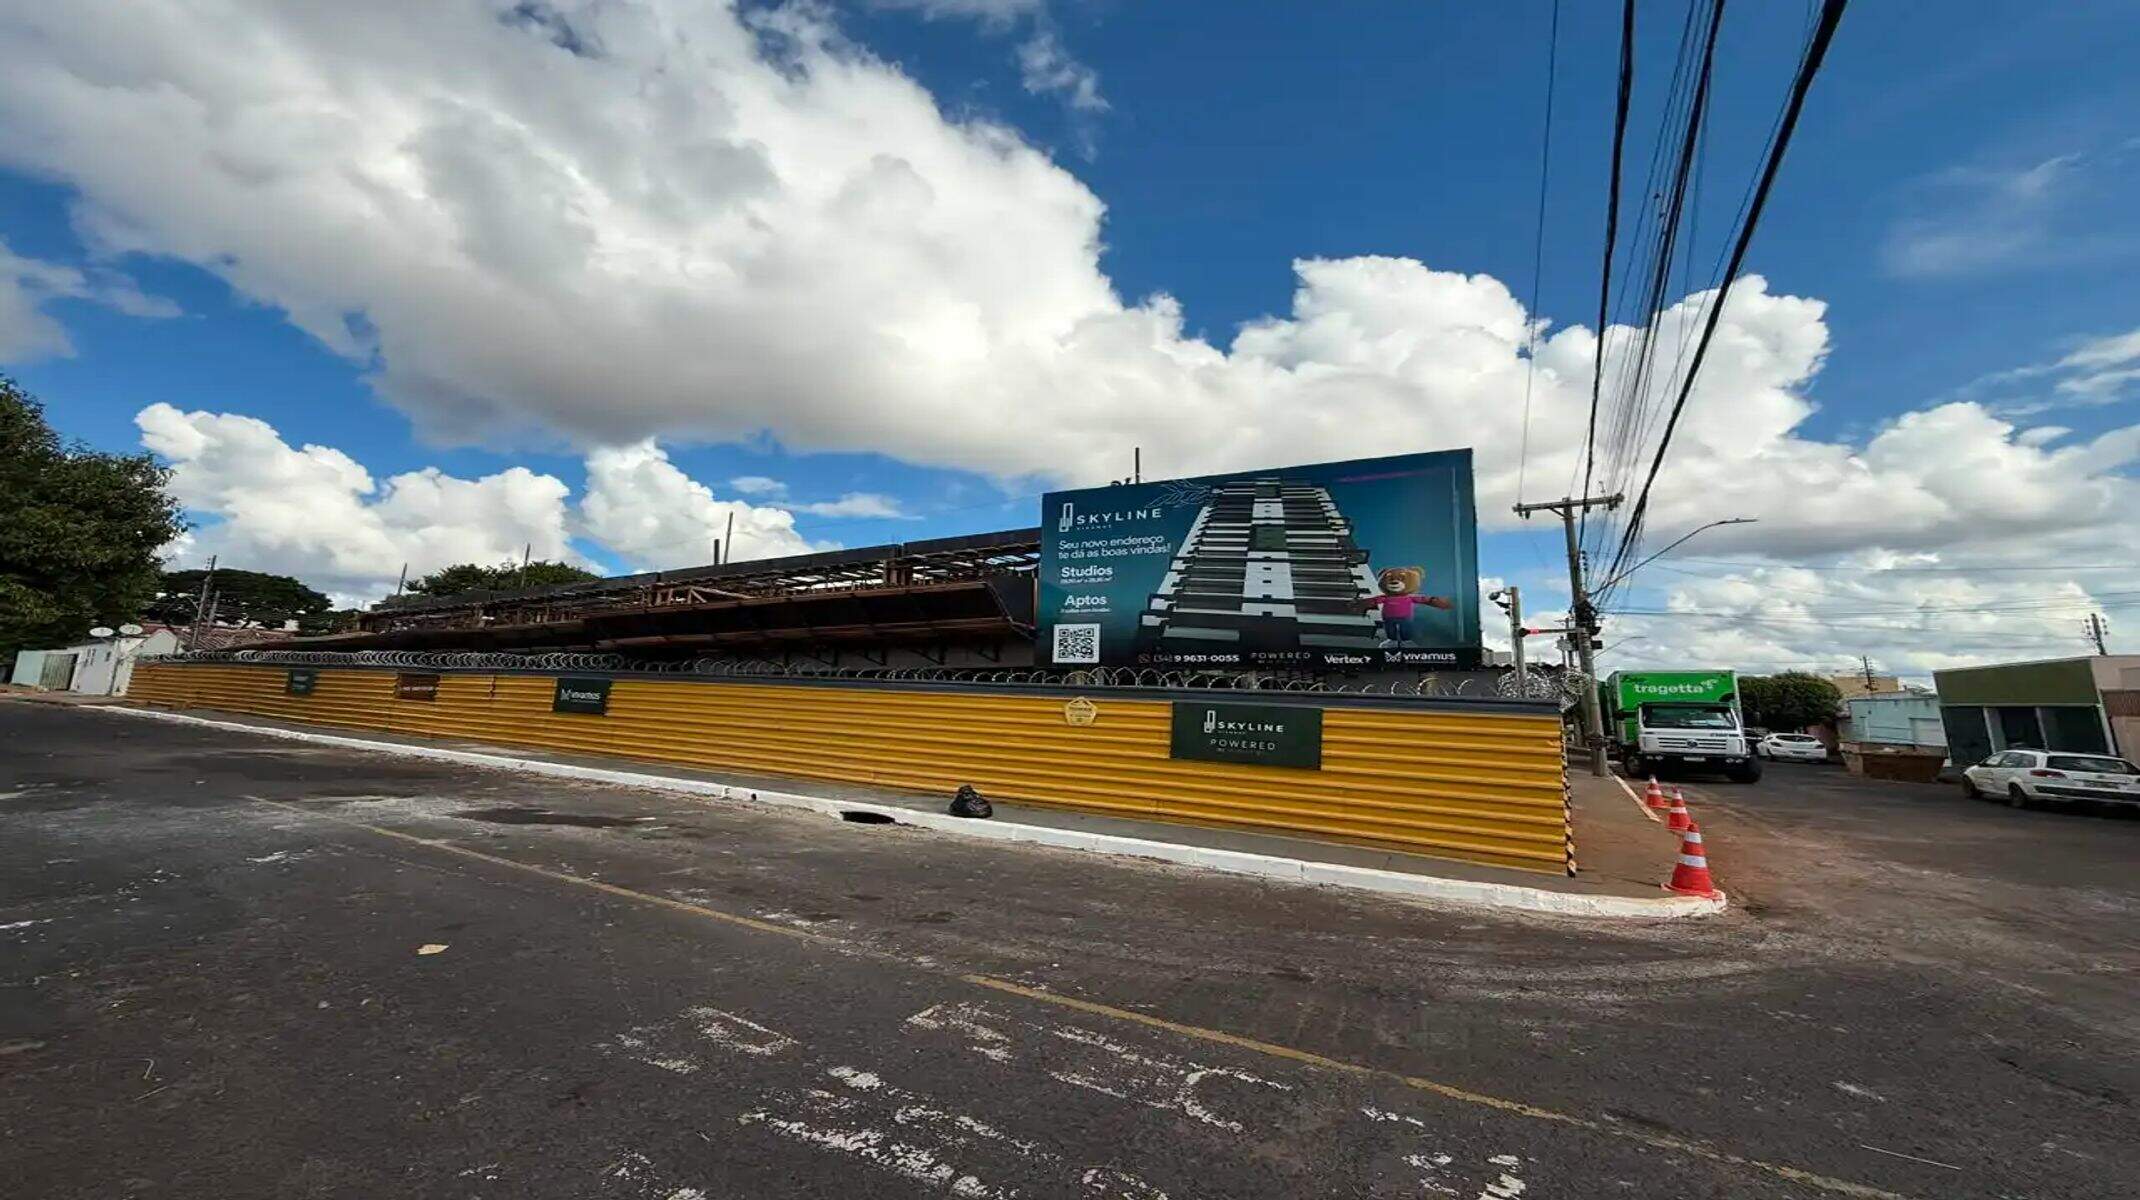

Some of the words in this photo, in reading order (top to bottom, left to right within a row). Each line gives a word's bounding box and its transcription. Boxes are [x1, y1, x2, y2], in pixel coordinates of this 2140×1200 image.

[1076, 508, 1162, 524] SKYLINE
[1059, 540, 1079, 550] Seu
[1081, 540, 1108, 548] novo
[1110, 535, 1165, 547] endereço
[1058, 549, 1069, 559] te
[1086, 550, 1100, 558] as
[1101, 547, 1128, 557] boas
[1130, 542, 1172, 555] vindas!
[1061, 565, 1113, 578] Studios
[1064, 594, 1107, 608] Aptos
[1251, 652, 1311, 660] POWERED
[1324, 654, 1364, 664] Vertex
[1403, 652, 1457, 661] vivamus
[1634, 684, 1704, 695] tragetta
[1217, 721, 1285, 732] SKYLINE
[1210, 738, 1276, 750] POWERED
